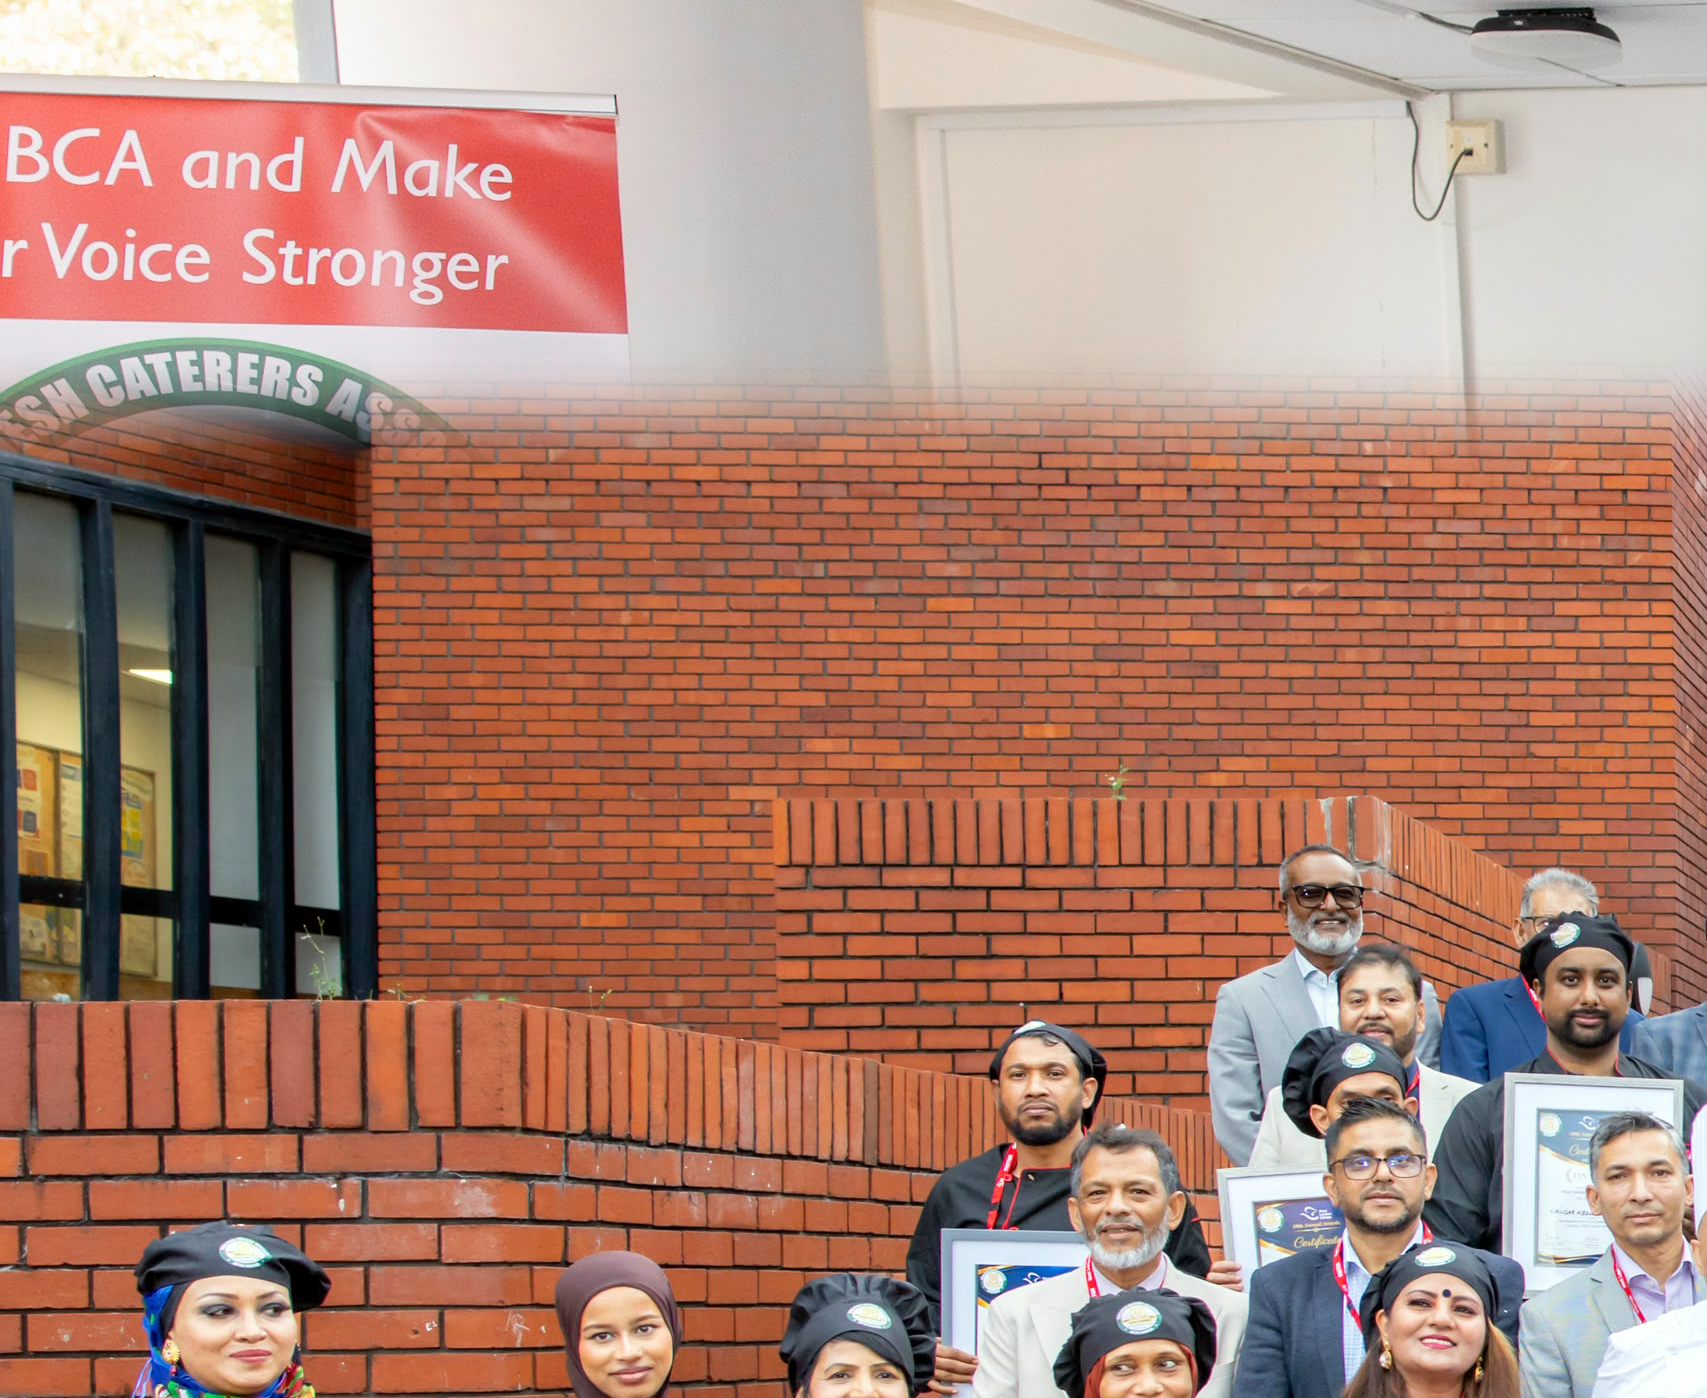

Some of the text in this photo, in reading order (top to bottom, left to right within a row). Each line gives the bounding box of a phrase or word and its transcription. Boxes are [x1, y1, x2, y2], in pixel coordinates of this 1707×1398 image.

[5, 126, 514, 203] BCA and Make
[41, 220, 212, 284] Voice
[242, 228, 509, 305] Stronger
[84, 349, 326, 410] CATERERS
